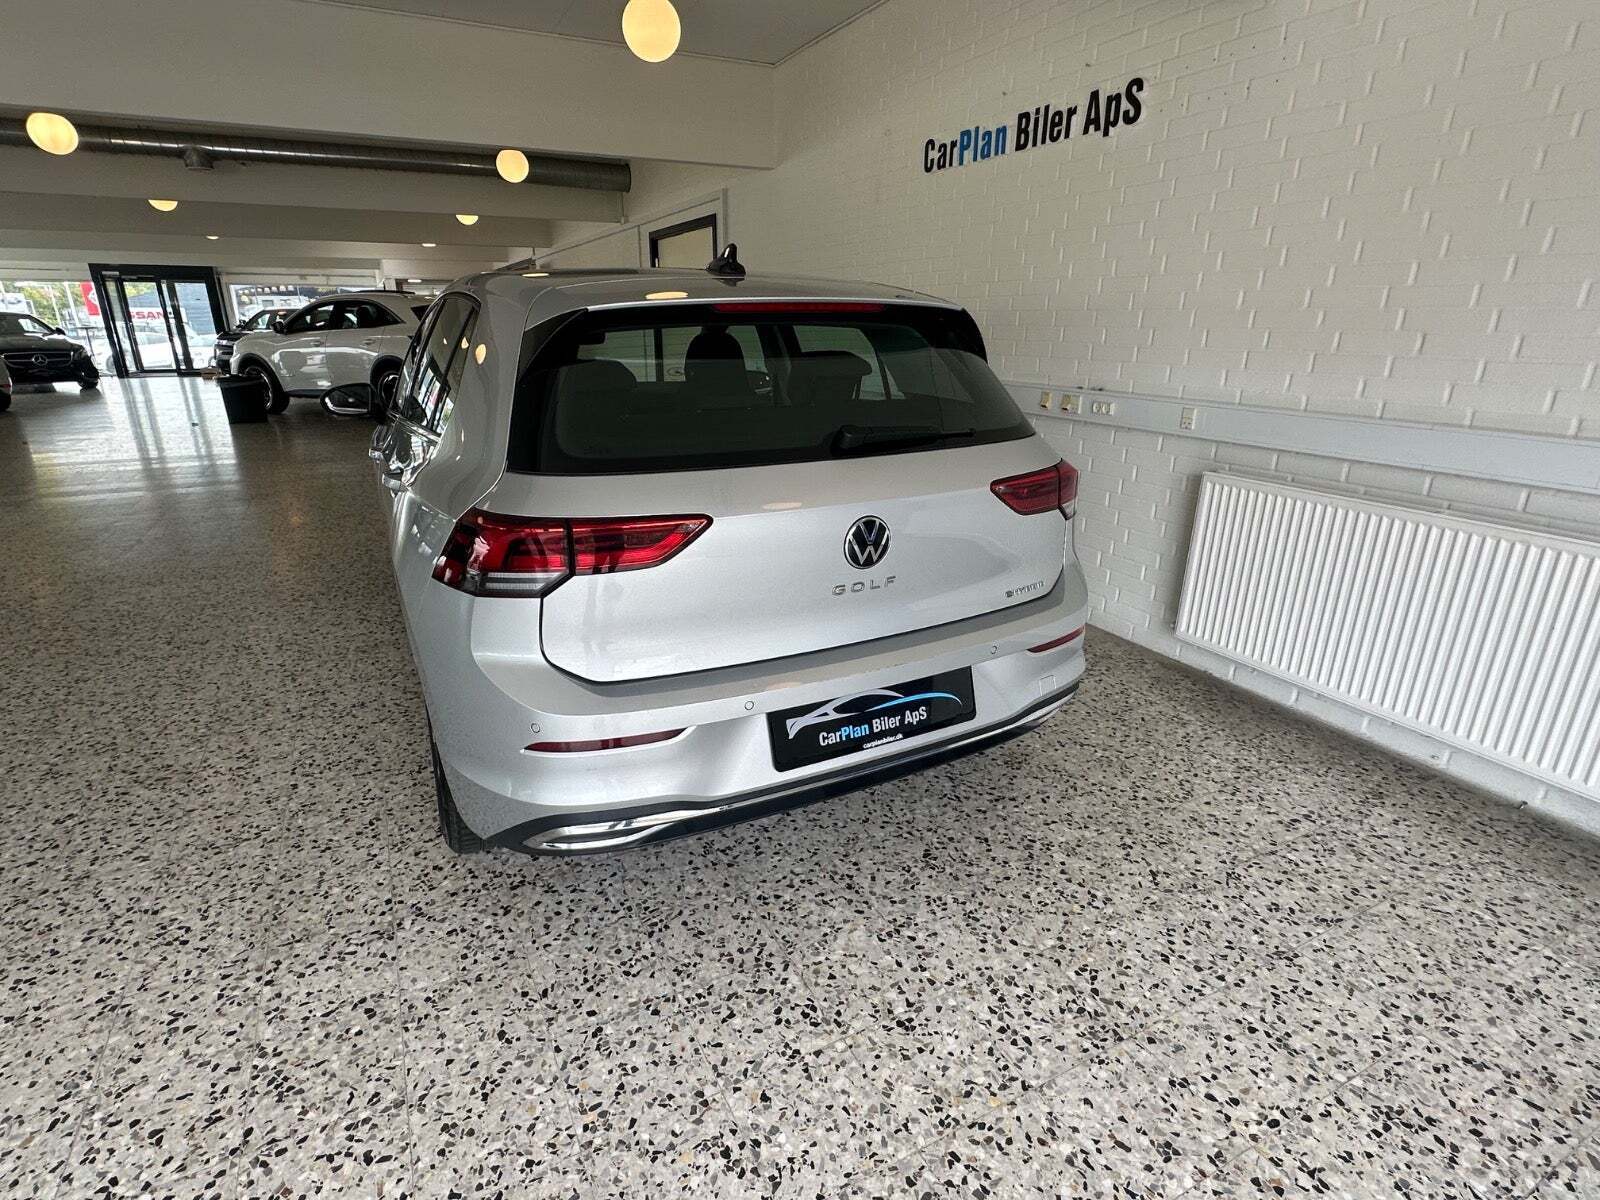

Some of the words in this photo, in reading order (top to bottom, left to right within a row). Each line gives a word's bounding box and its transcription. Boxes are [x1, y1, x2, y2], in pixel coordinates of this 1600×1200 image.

[923, 125, 1008, 174] CarPlan
[1014, 103, 1078, 152] Biler
[1082, 77, 1145, 138] ApS
[831, 575, 896, 596] GOLF
[819, 723, 869, 746] CarPlan
[872, 715, 901, 733] Biler
[904, 706, 927, 725] ApS
